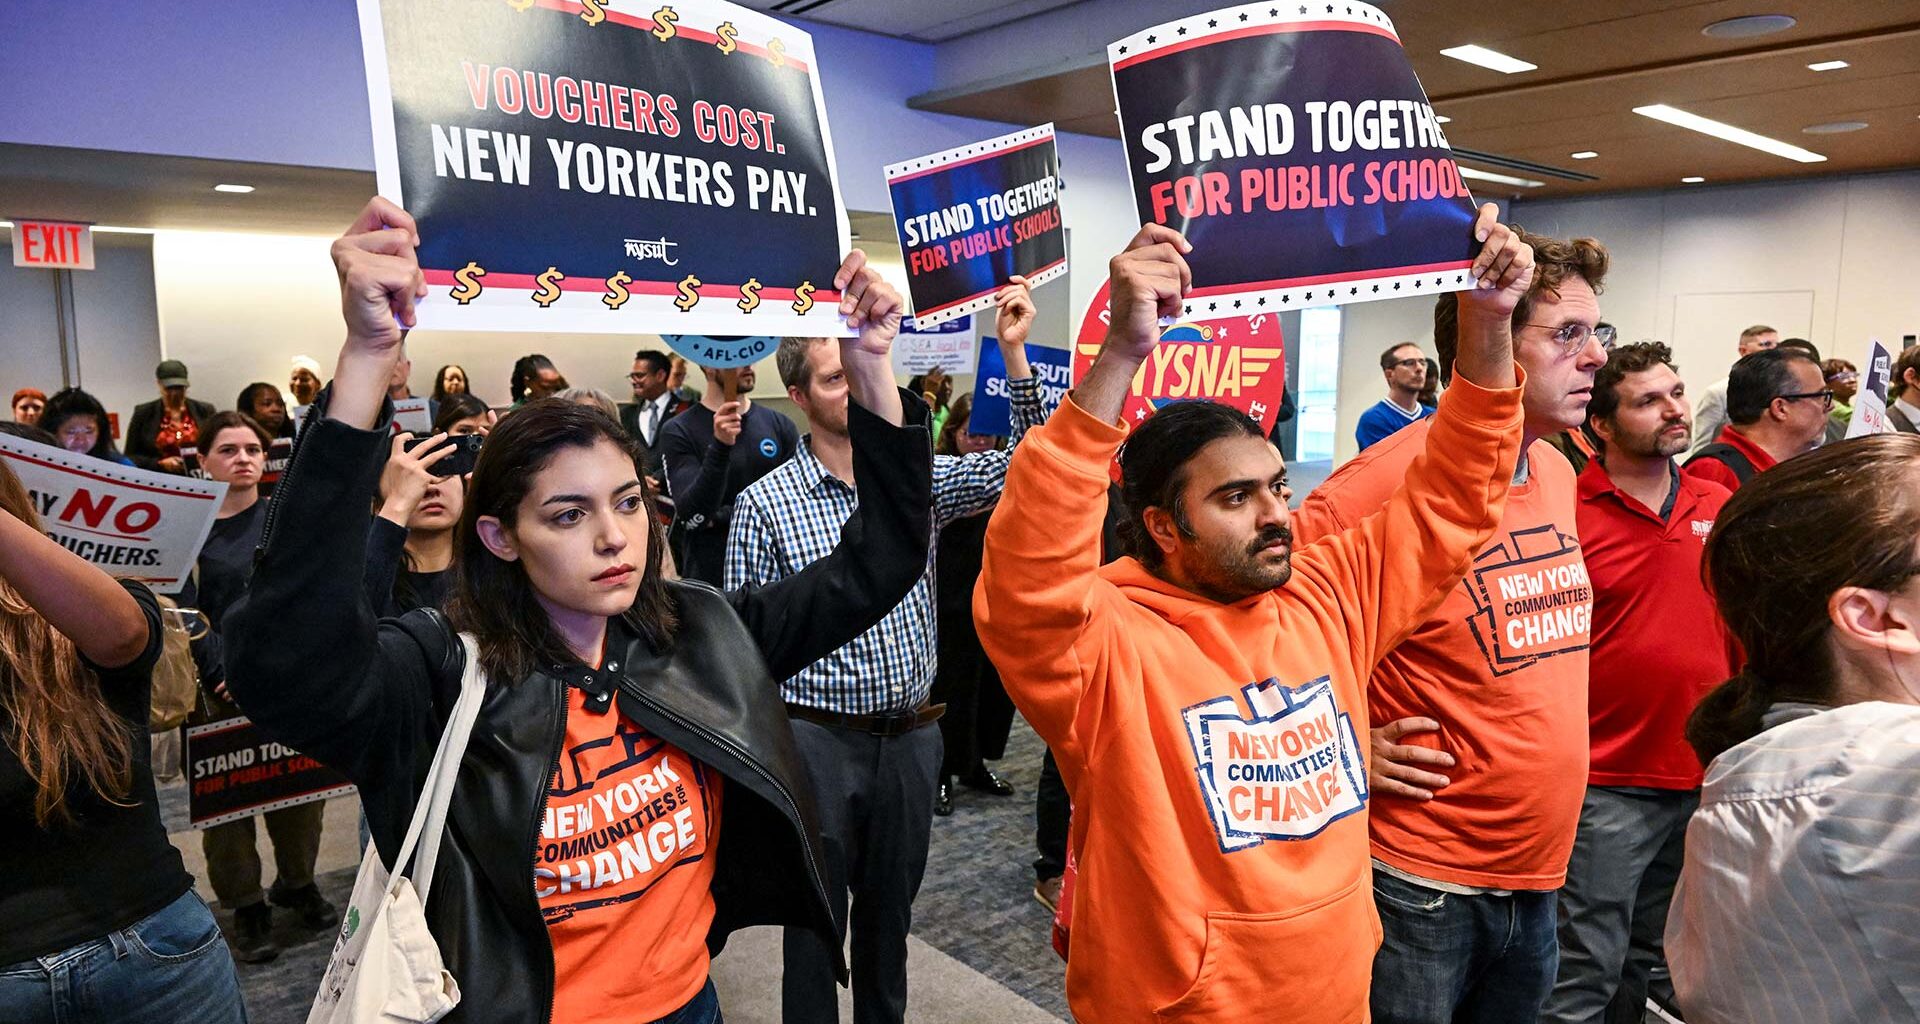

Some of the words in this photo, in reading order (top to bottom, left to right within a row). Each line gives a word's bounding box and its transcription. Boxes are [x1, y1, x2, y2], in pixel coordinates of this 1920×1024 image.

[463, 61, 681, 138] VOUCHERS
[692, 100, 786, 155] COST.
[1141, 103, 1294, 174] STAND
[1305, 100, 1450, 153] TOGETHE
[431, 124, 531, 186] NEW
[547, 137, 735, 208] YORKERS
[747, 167, 818, 216] PAY.
[1150, 170, 1232, 225] FOR
[1240, 163, 1354, 213] PUBLIC
[1363, 158, 1469, 204] SCHOOL
[22, 223, 82, 264] EXIT
[904, 202, 975, 248] STAND
[976, 175, 1057, 225] TOGETHER
[910, 245, 948, 276] FOR
[950, 225, 1012, 264] PUBLIC
[1013, 206, 1060, 244] SCHOOLS
[623, 237, 678, 266] nysut
[703, 340, 765, 361] AFL-CIO
[58, 488, 161, 534] NO
[1497, 570, 1544, 600] NEW
[1505, 587, 1588, 617] COMMUNITIES
[194, 748, 255, 779] STAND
[541, 797, 594, 839] NEW
[593, 755, 681, 823] YORK
[535, 806, 697, 898] CHANGE
